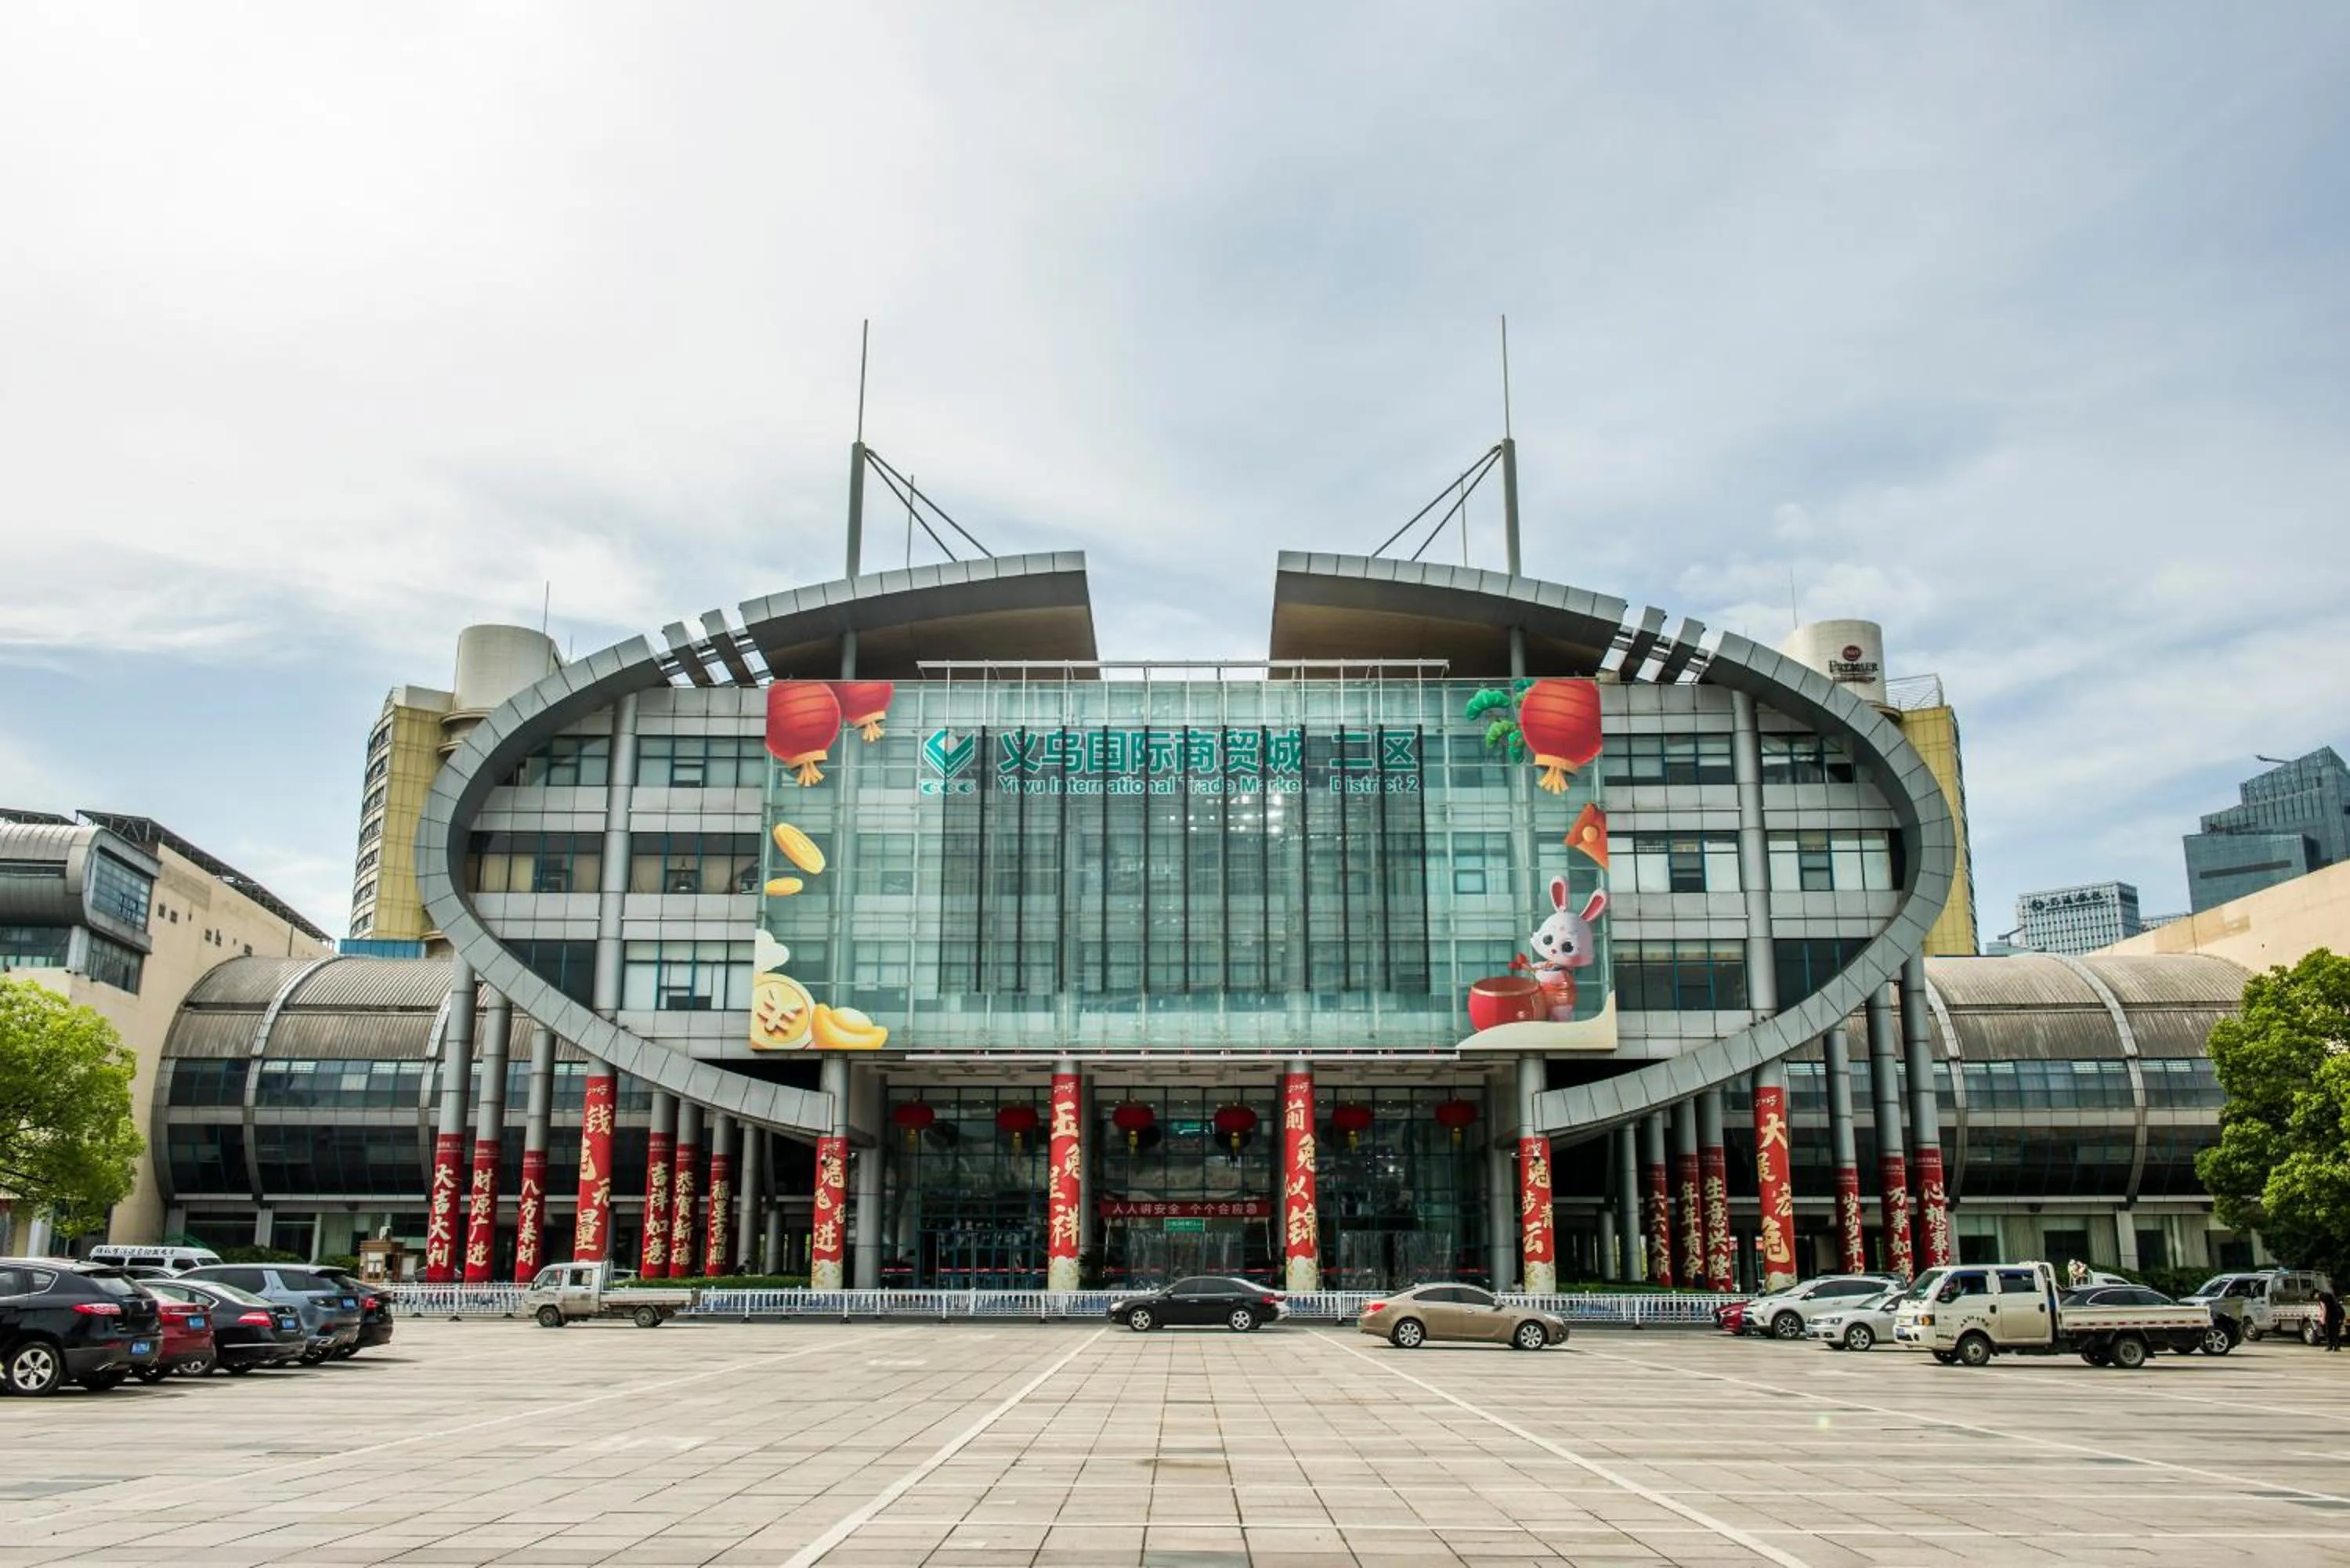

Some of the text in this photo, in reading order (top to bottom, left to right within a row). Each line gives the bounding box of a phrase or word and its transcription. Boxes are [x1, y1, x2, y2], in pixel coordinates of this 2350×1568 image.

[998, 728, 1417, 774] 义乌国际商贸城 二区
[1407, 775, 1419, 793] 2
[428, 1163, 456, 1268] 大吉大利
[466, 1168, 494, 1266] 财源广进
[517, 1178, 540, 1266] 八方来财
[645, 1161, 669, 1266] 吉祥如意
[1112, 1203, 1181, 1215] 人人讲安全
